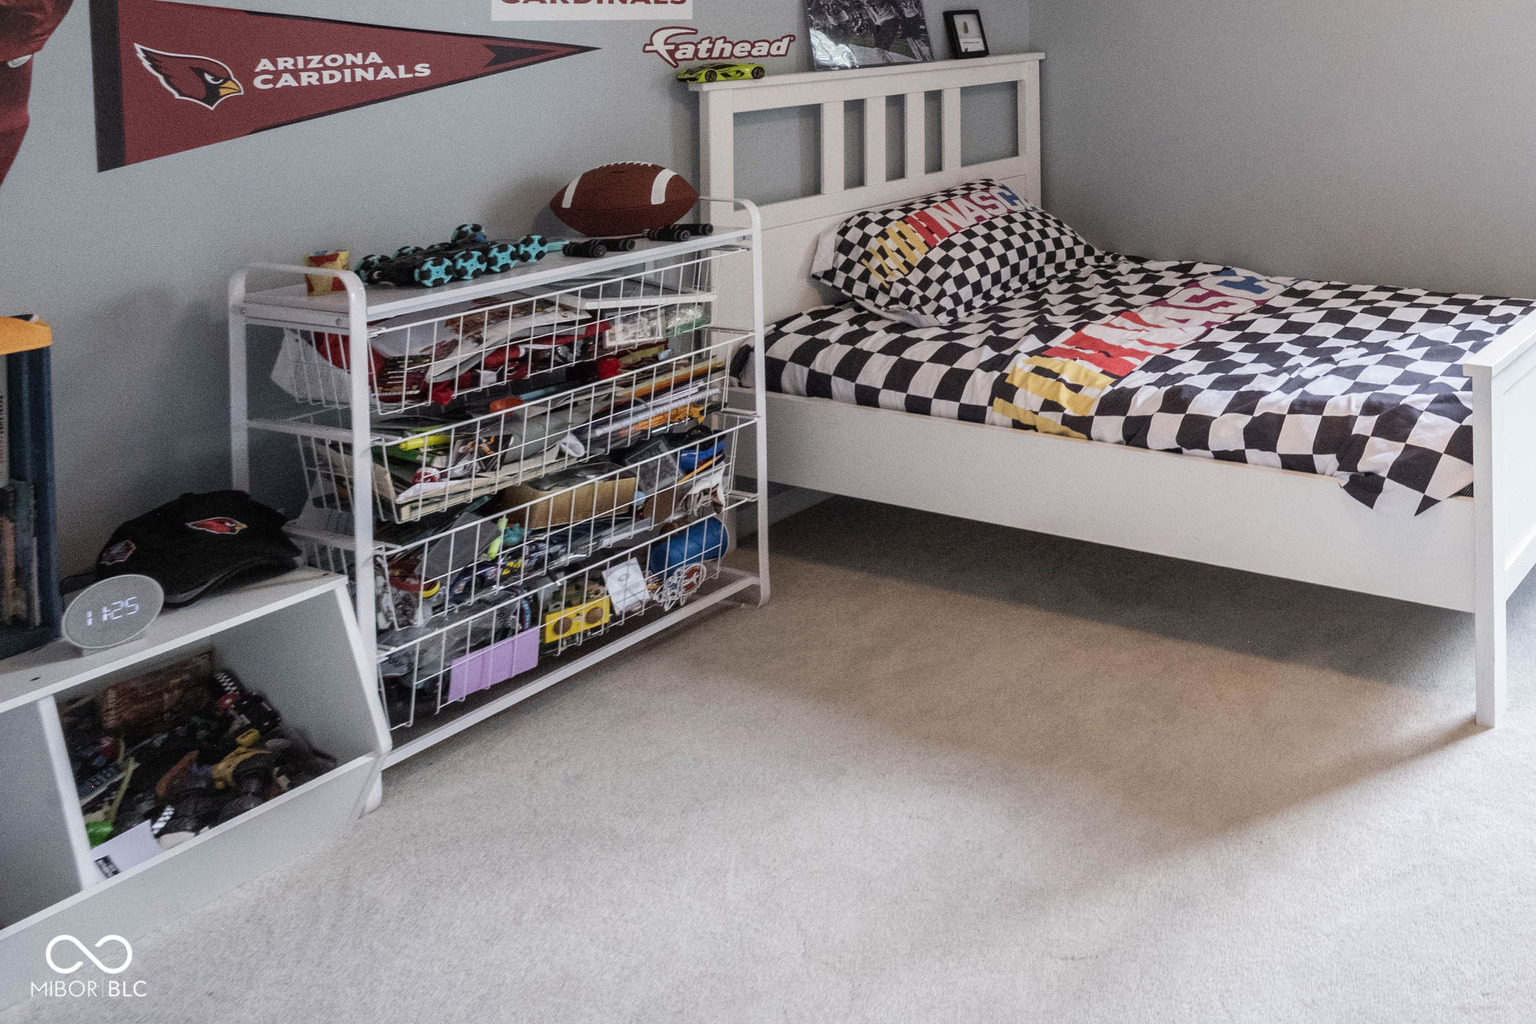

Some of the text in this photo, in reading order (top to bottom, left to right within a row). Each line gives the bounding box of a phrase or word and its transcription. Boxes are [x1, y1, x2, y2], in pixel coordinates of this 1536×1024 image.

[643, 26, 795, 68] Fathead
[254, 51, 383, 72] ARIZONA
[253, 63, 431, 90] CARDINALS
